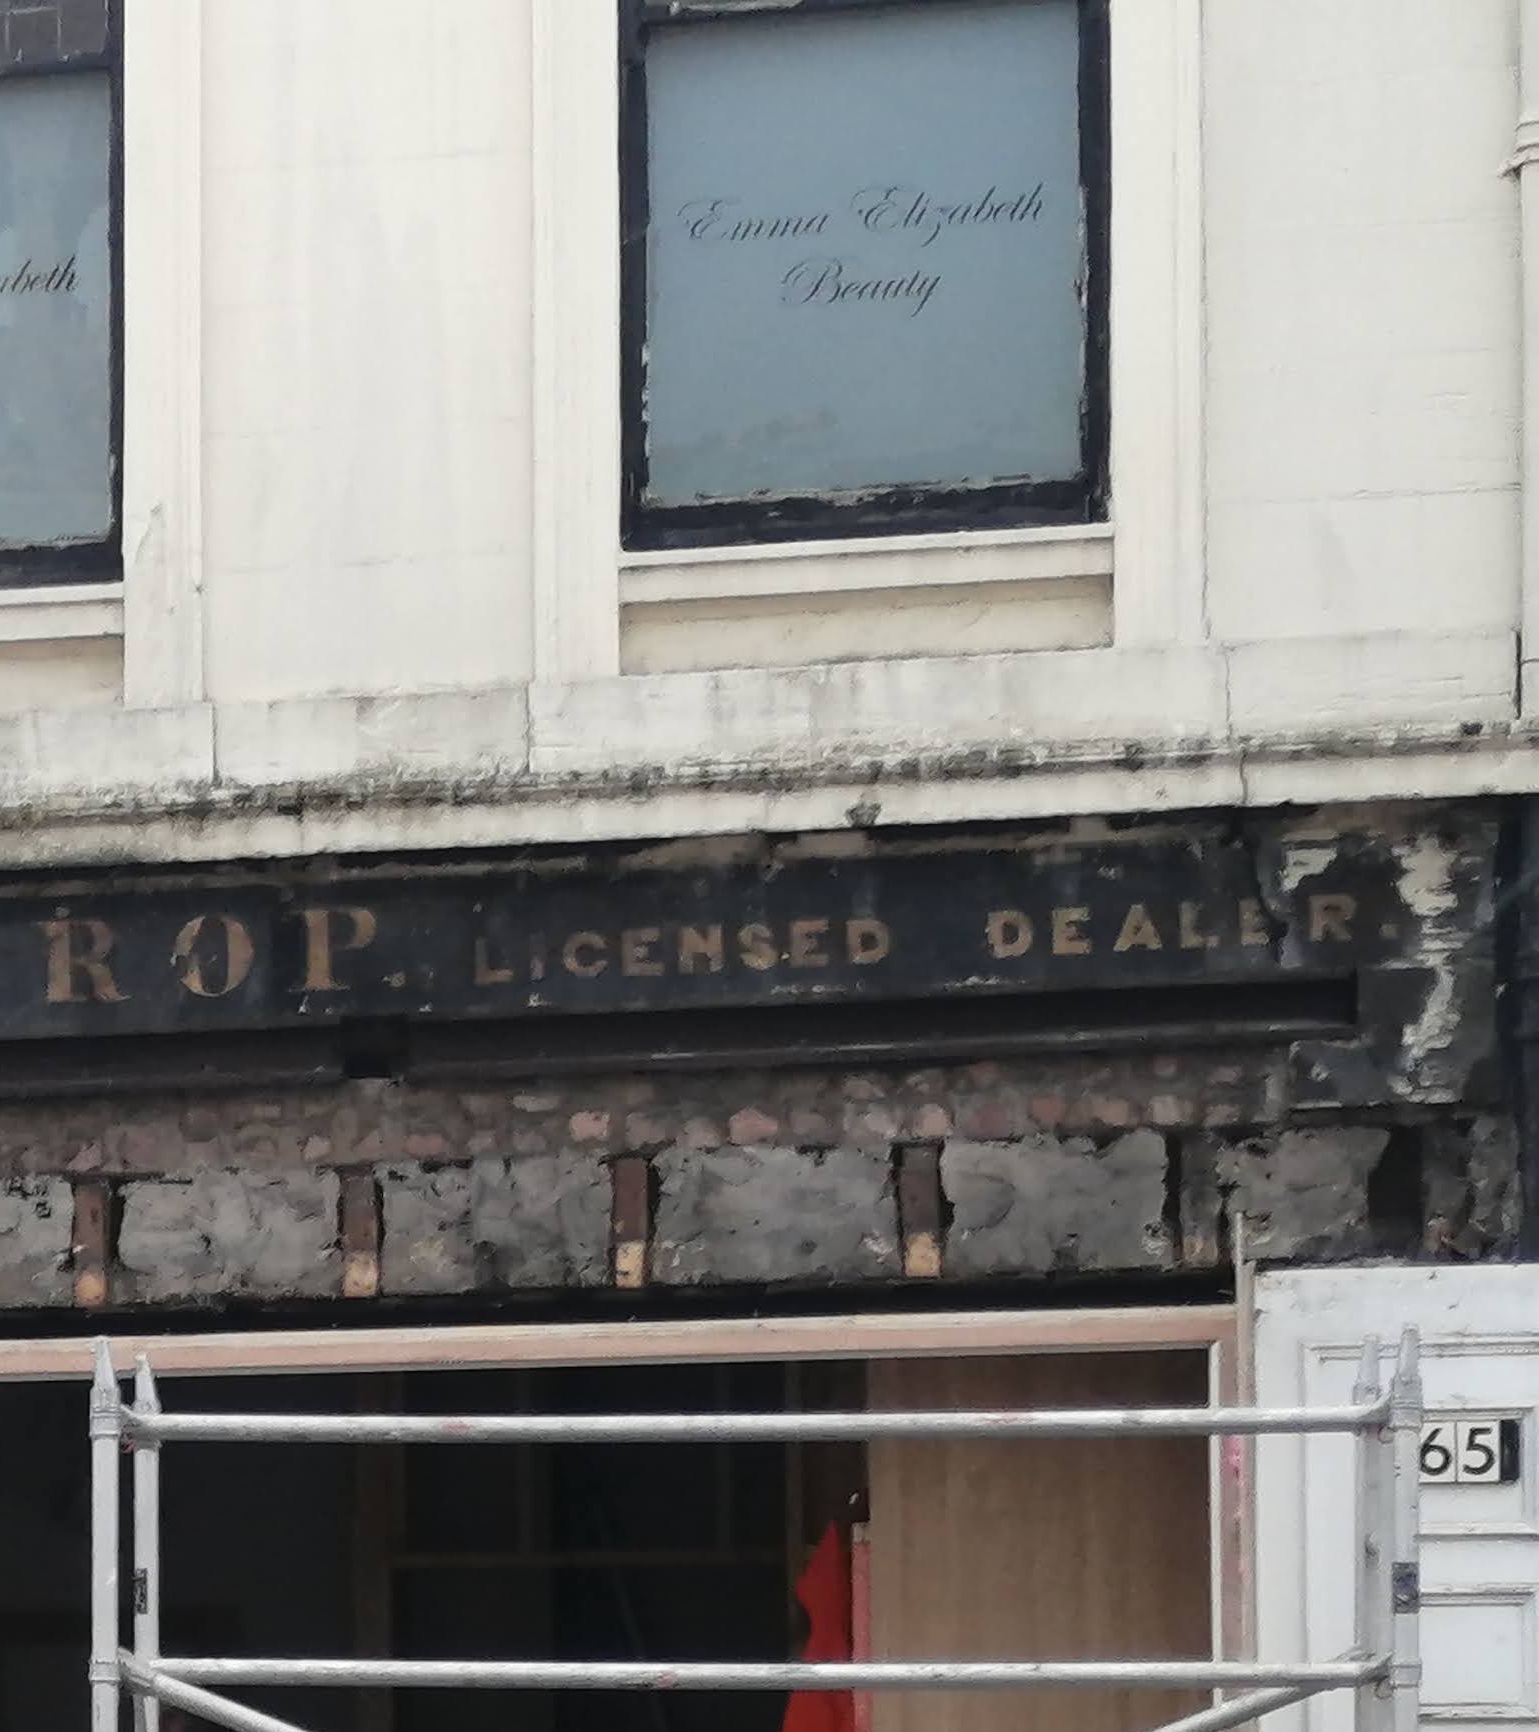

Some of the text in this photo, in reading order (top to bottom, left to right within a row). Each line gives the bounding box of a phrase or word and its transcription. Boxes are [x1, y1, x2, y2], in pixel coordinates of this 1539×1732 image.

[677, 182, 1044, 248] Emma Elizabeth
[781, 256, 943, 318] Beauty
[474, 918, 891, 986] LICENSED
[1420, 1427, 1495, 1476] 65
